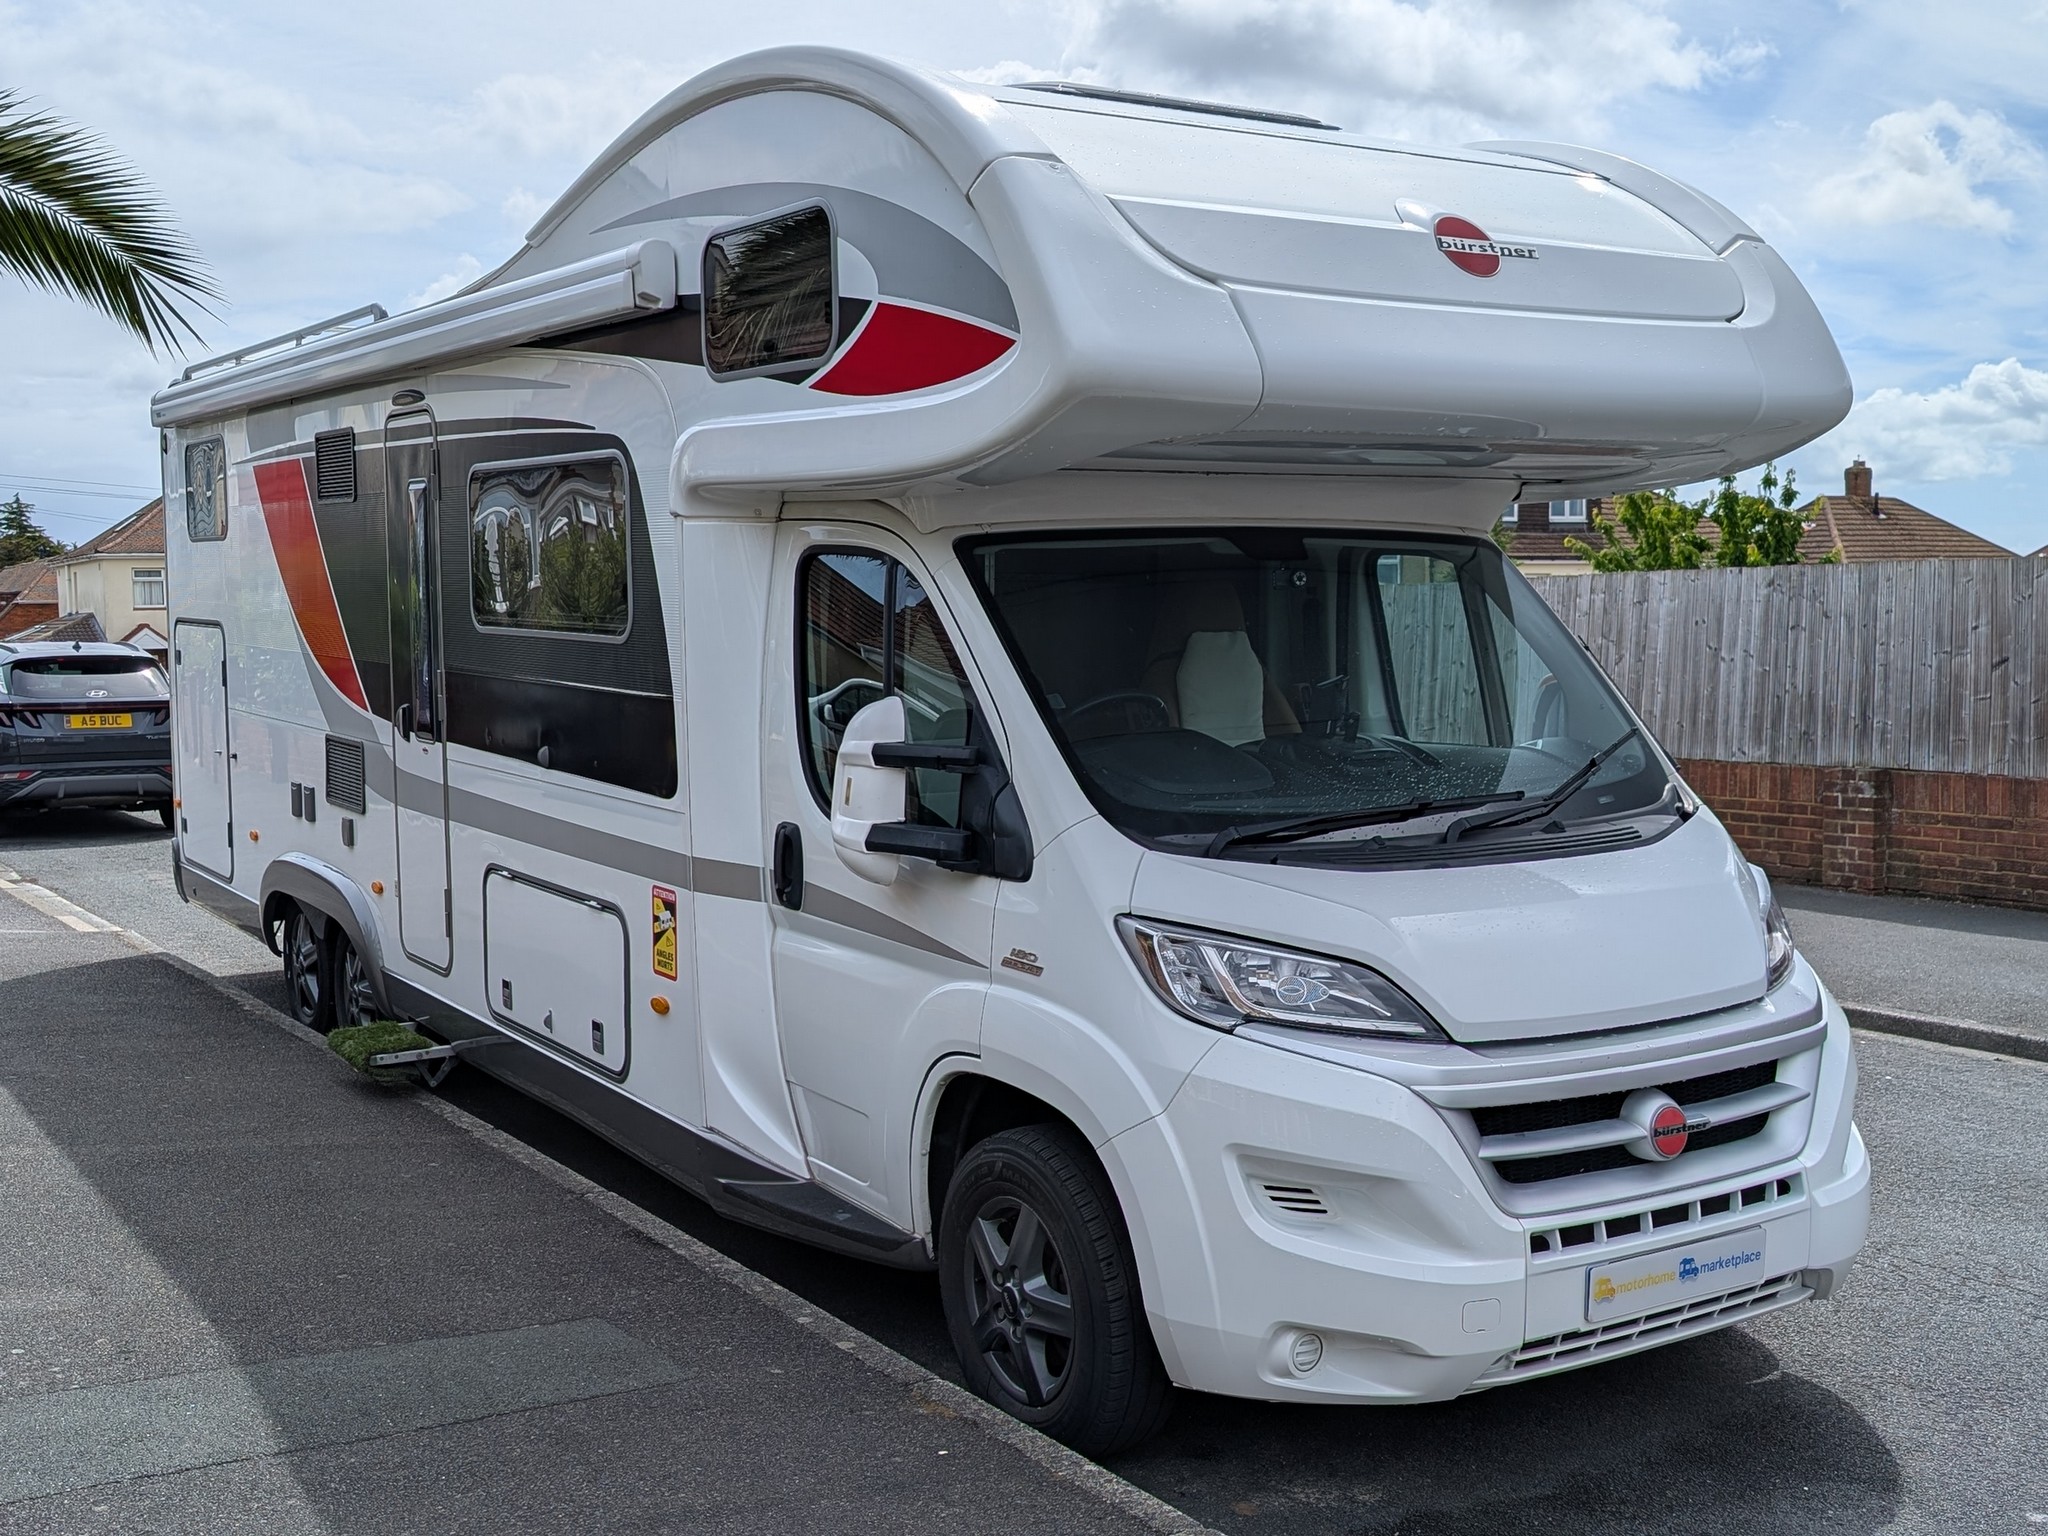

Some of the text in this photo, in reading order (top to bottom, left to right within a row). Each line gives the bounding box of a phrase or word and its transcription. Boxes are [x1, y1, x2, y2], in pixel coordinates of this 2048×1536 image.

[1437, 236, 1537, 259] bürstner
[81, 715, 97, 727] A5
[99, 715, 122, 726] BUC
[1653, 1121, 1710, 1138] bürstner
[1615, 1250, 1762, 1294] motorhome marketplace
